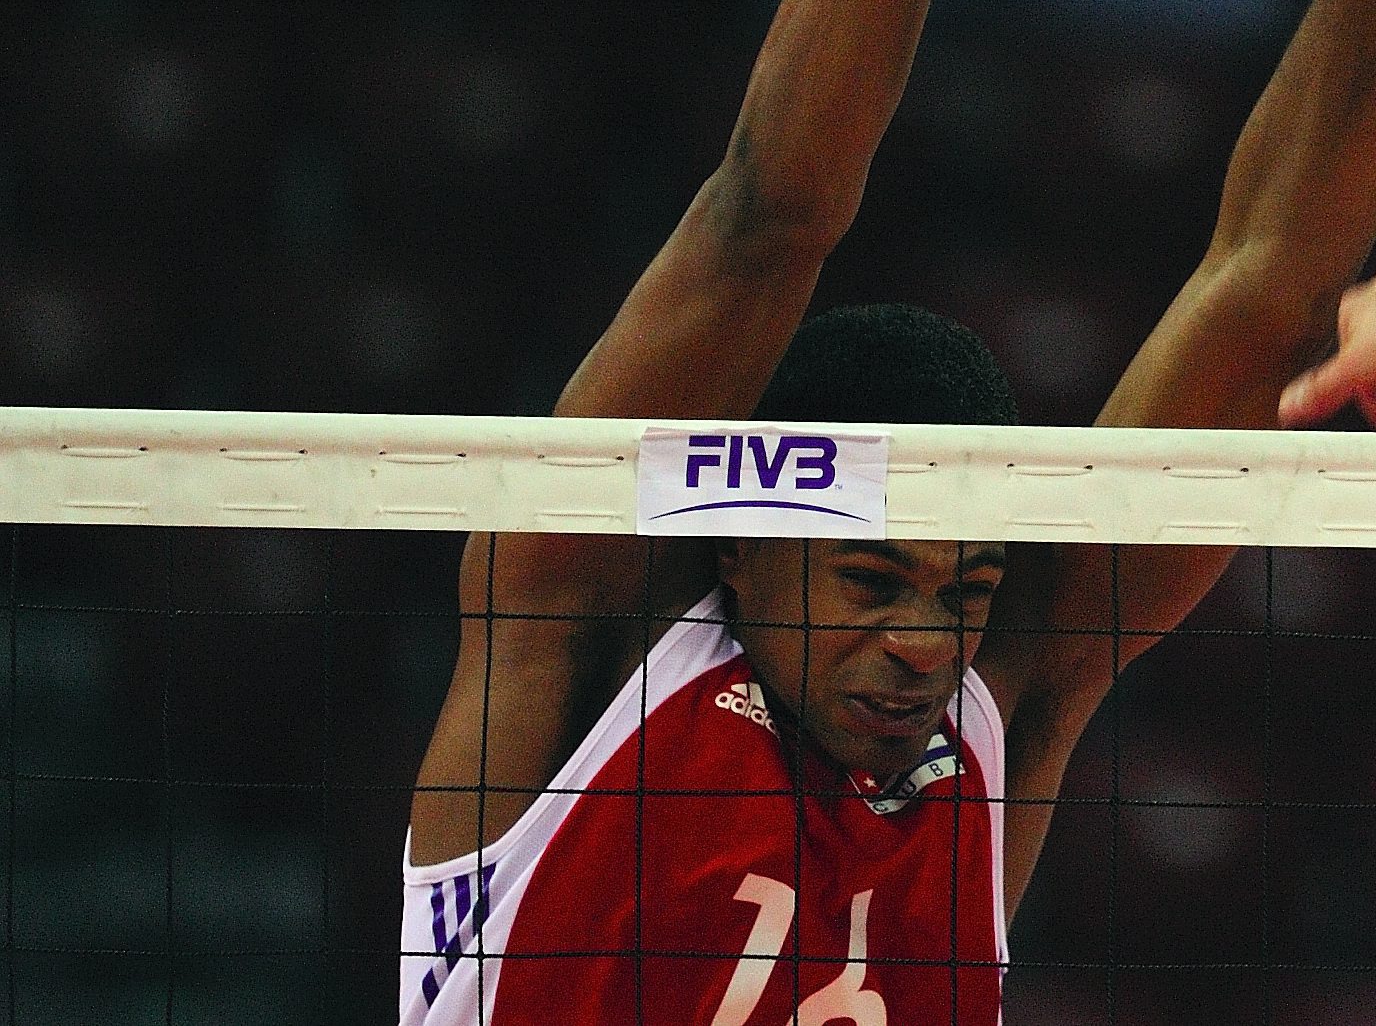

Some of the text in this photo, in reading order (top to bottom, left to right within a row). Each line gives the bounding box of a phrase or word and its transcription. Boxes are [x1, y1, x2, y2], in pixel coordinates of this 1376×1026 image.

[686, 435, 838, 490] FIVB
[715, 692, 780, 741] adida
[872, 759, 960, 812] CUB
